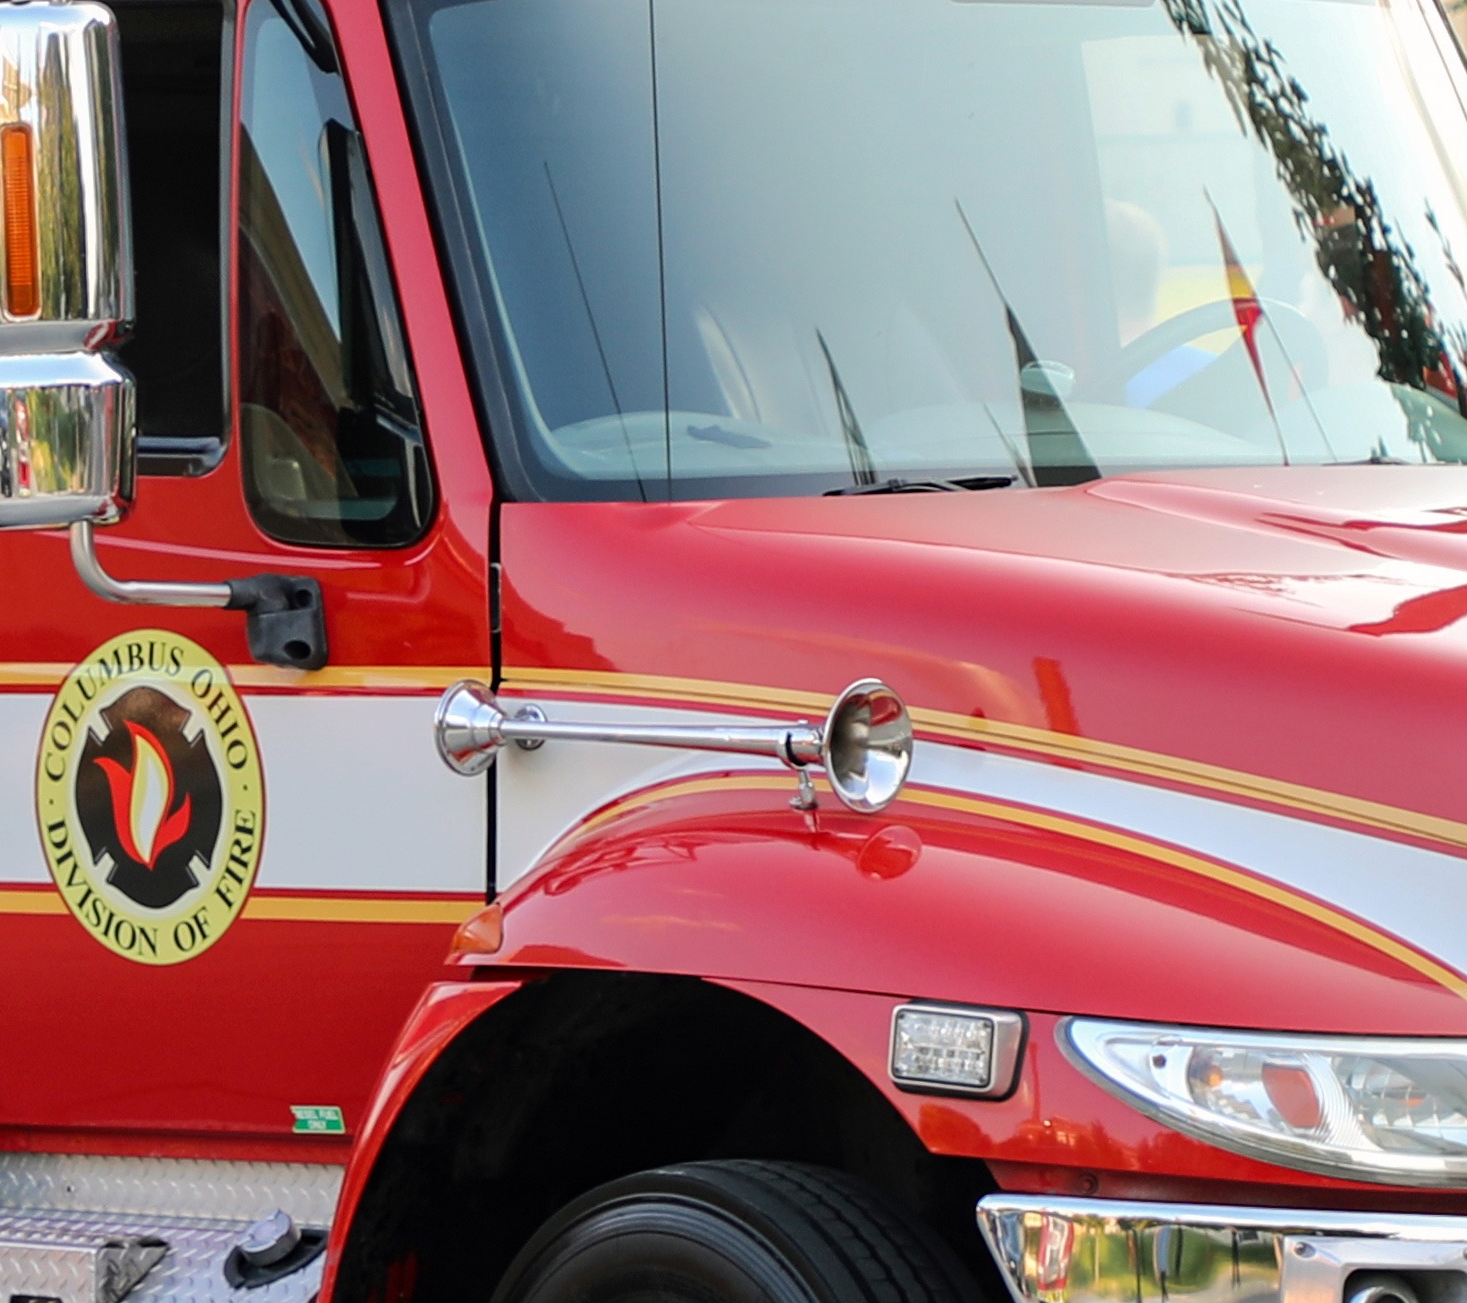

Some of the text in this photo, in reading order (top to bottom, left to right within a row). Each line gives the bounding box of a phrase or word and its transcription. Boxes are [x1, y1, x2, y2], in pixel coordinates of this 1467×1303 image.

[44, 640, 249, 784] COLUMBUS OHIO
[47, 808, 257, 958] DIVISION OF FIRE
